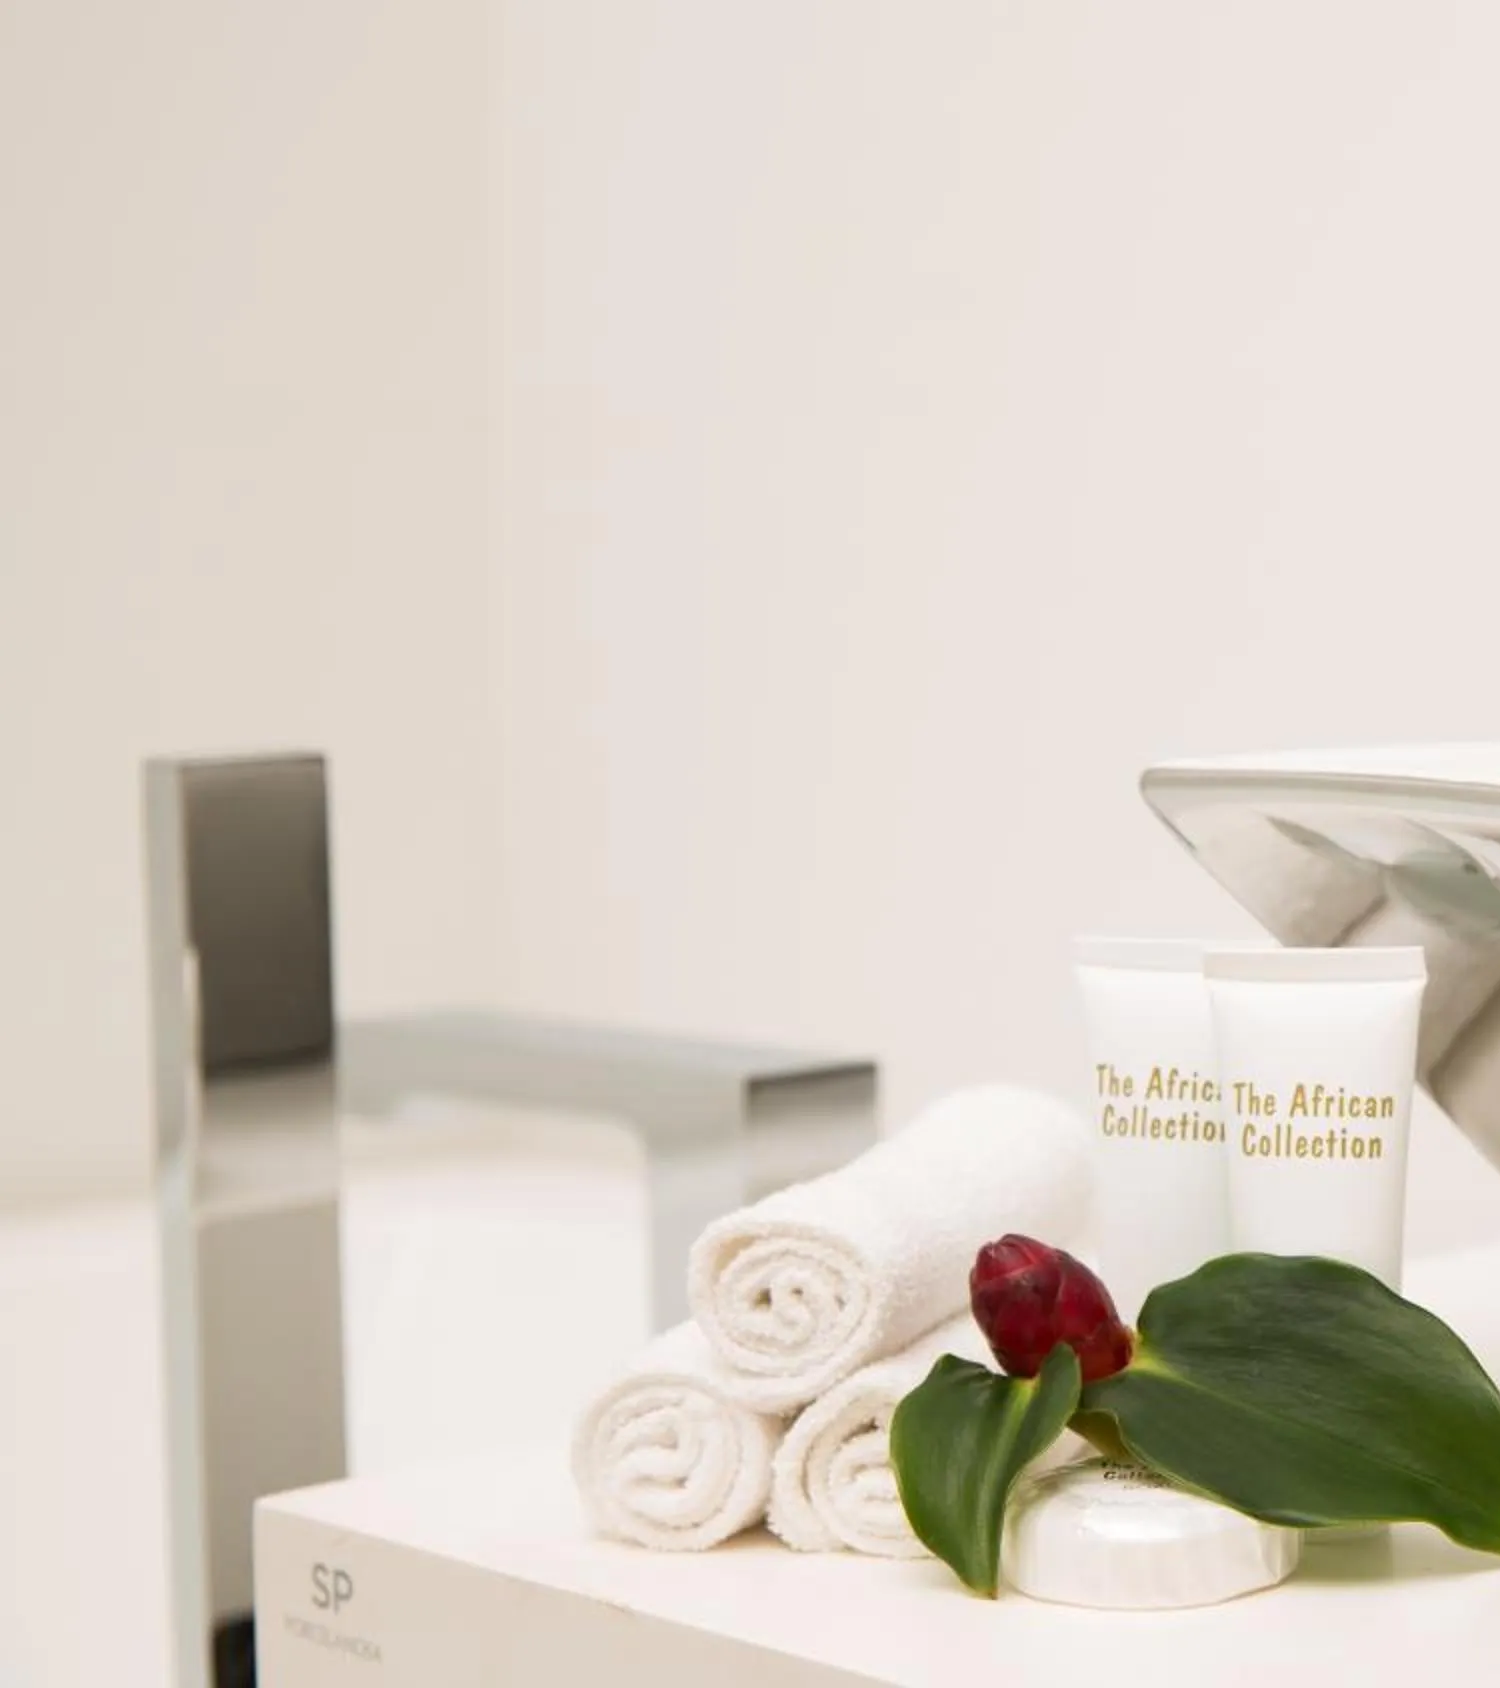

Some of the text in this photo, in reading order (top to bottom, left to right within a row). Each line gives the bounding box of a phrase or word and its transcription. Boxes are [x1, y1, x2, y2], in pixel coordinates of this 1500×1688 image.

[1096, 1064, 1222, 1101] The Afric
[1233, 1082, 1394, 1118] The African
[1242, 1123, 1382, 1159] Collection
[311, 1562, 354, 1615] SP
